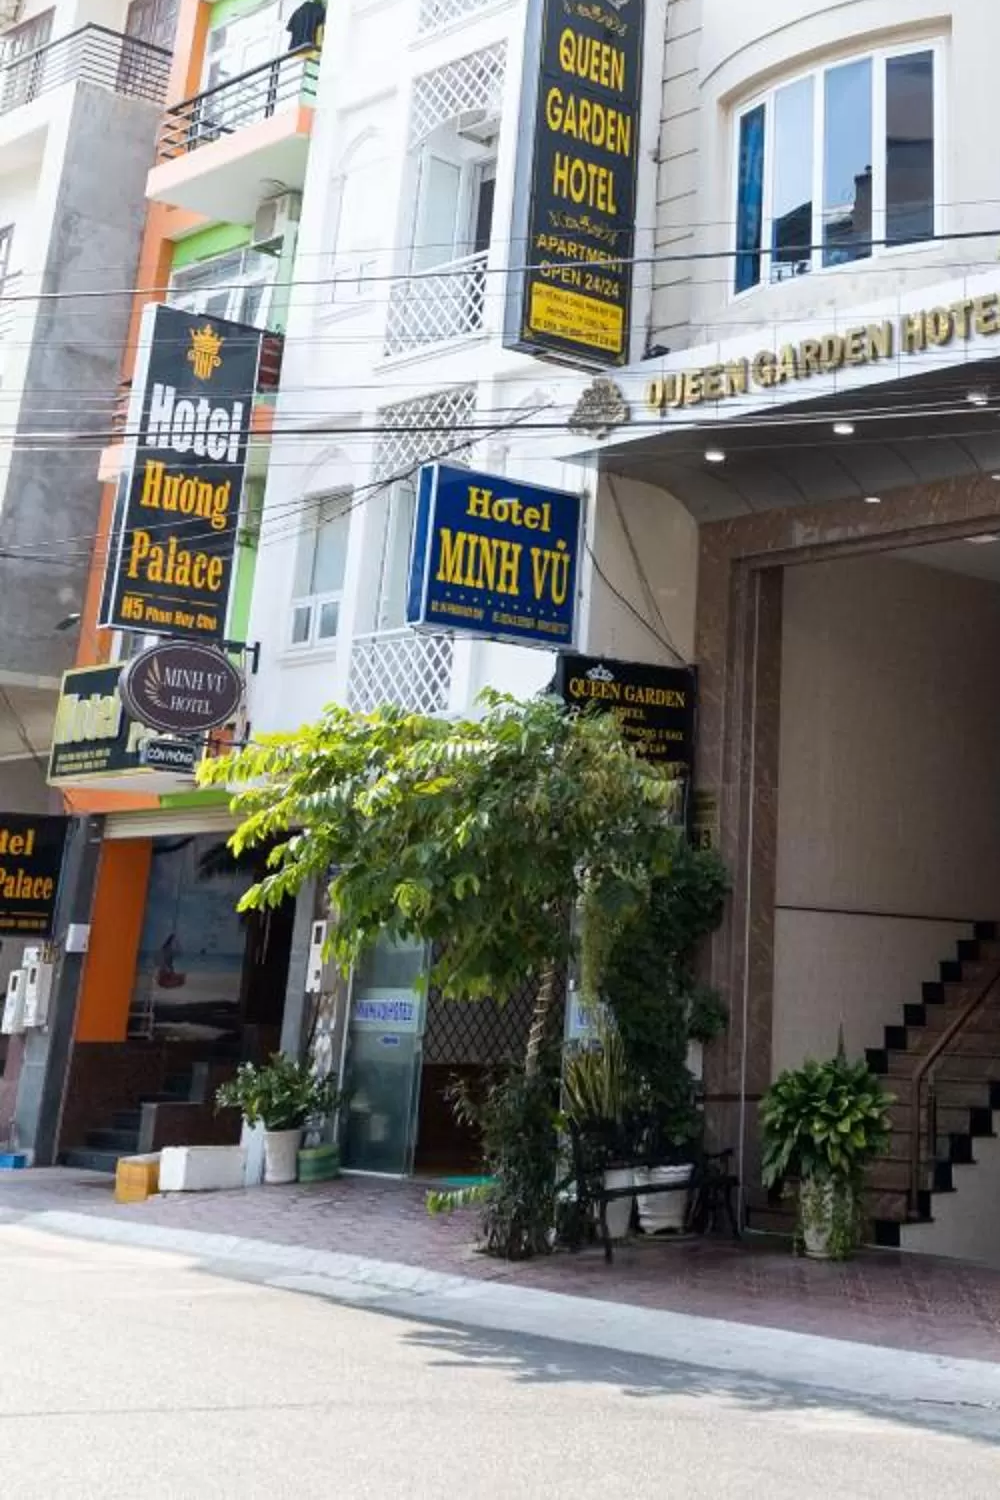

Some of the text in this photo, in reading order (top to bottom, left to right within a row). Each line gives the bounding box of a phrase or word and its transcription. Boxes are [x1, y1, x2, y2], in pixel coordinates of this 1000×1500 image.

[559, 27, 625, 93] QUEEN
[546, 86, 631, 157] GARDEN
[553, 151, 617, 215] HOTEL
[536, 233, 623, 274] APARTMENT
[540, 259, 581, 287] OPEN
[646, 357, 748, 415] QUEEN
[753, 320, 895, 386] GARDEN
[145, 383, 243, 463] Hotel
[466, 485, 551, 533] Hotel
[126, 530, 223, 593] Palace
[436, 528, 523, 596] MINH
[162, 666, 203, 690] MINH
[169, 695, 213, 716] HOTEL
[569, 676, 687, 708] QUEEN GARDEN
